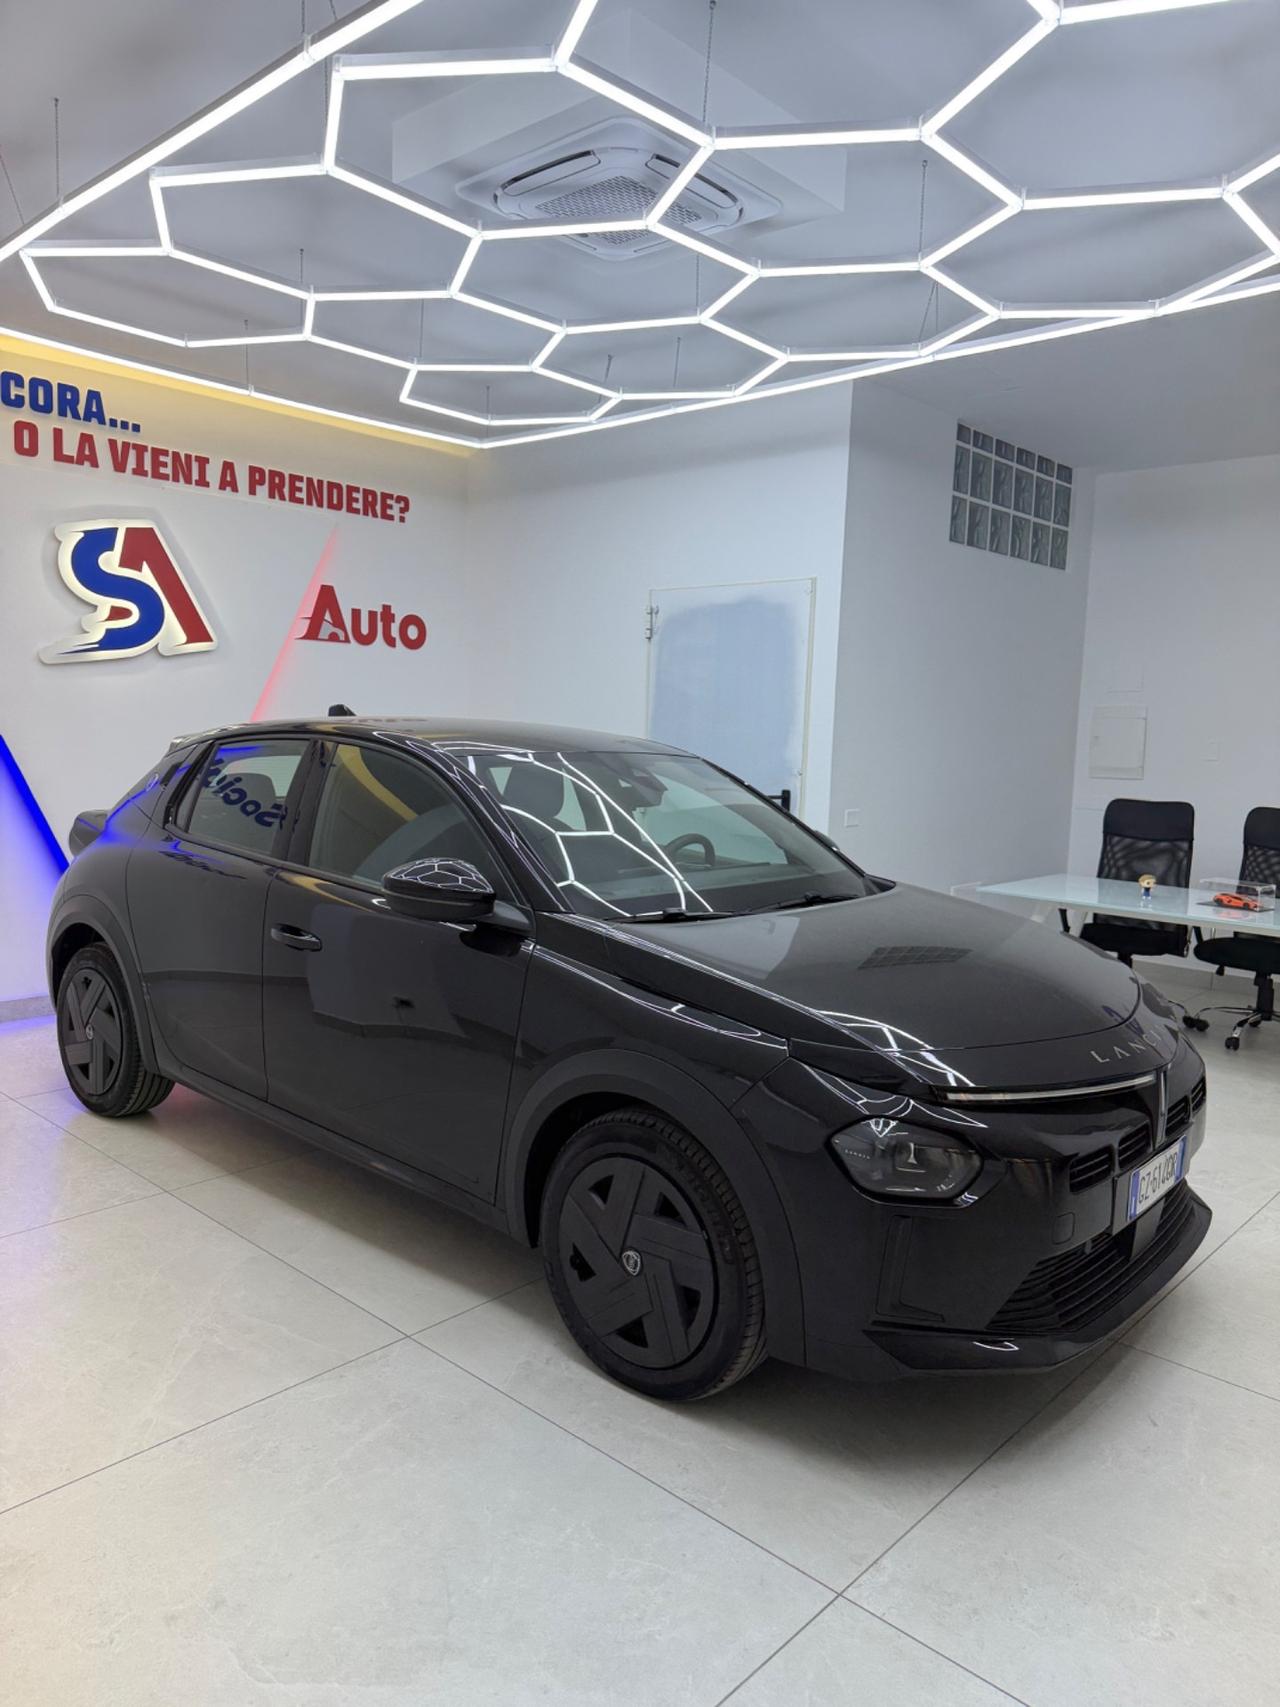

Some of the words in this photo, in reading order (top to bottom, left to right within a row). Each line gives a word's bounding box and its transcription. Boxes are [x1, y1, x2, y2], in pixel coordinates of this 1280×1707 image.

[14, 420, 39, 457] O
[53, 427, 99, 468] LA
[108, 438, 210, 489] VIENI
[219, 460, 239, 493] A
[248, 465, 410, 523] PRENDERE?
[297, 584, 427, 650] Auto
